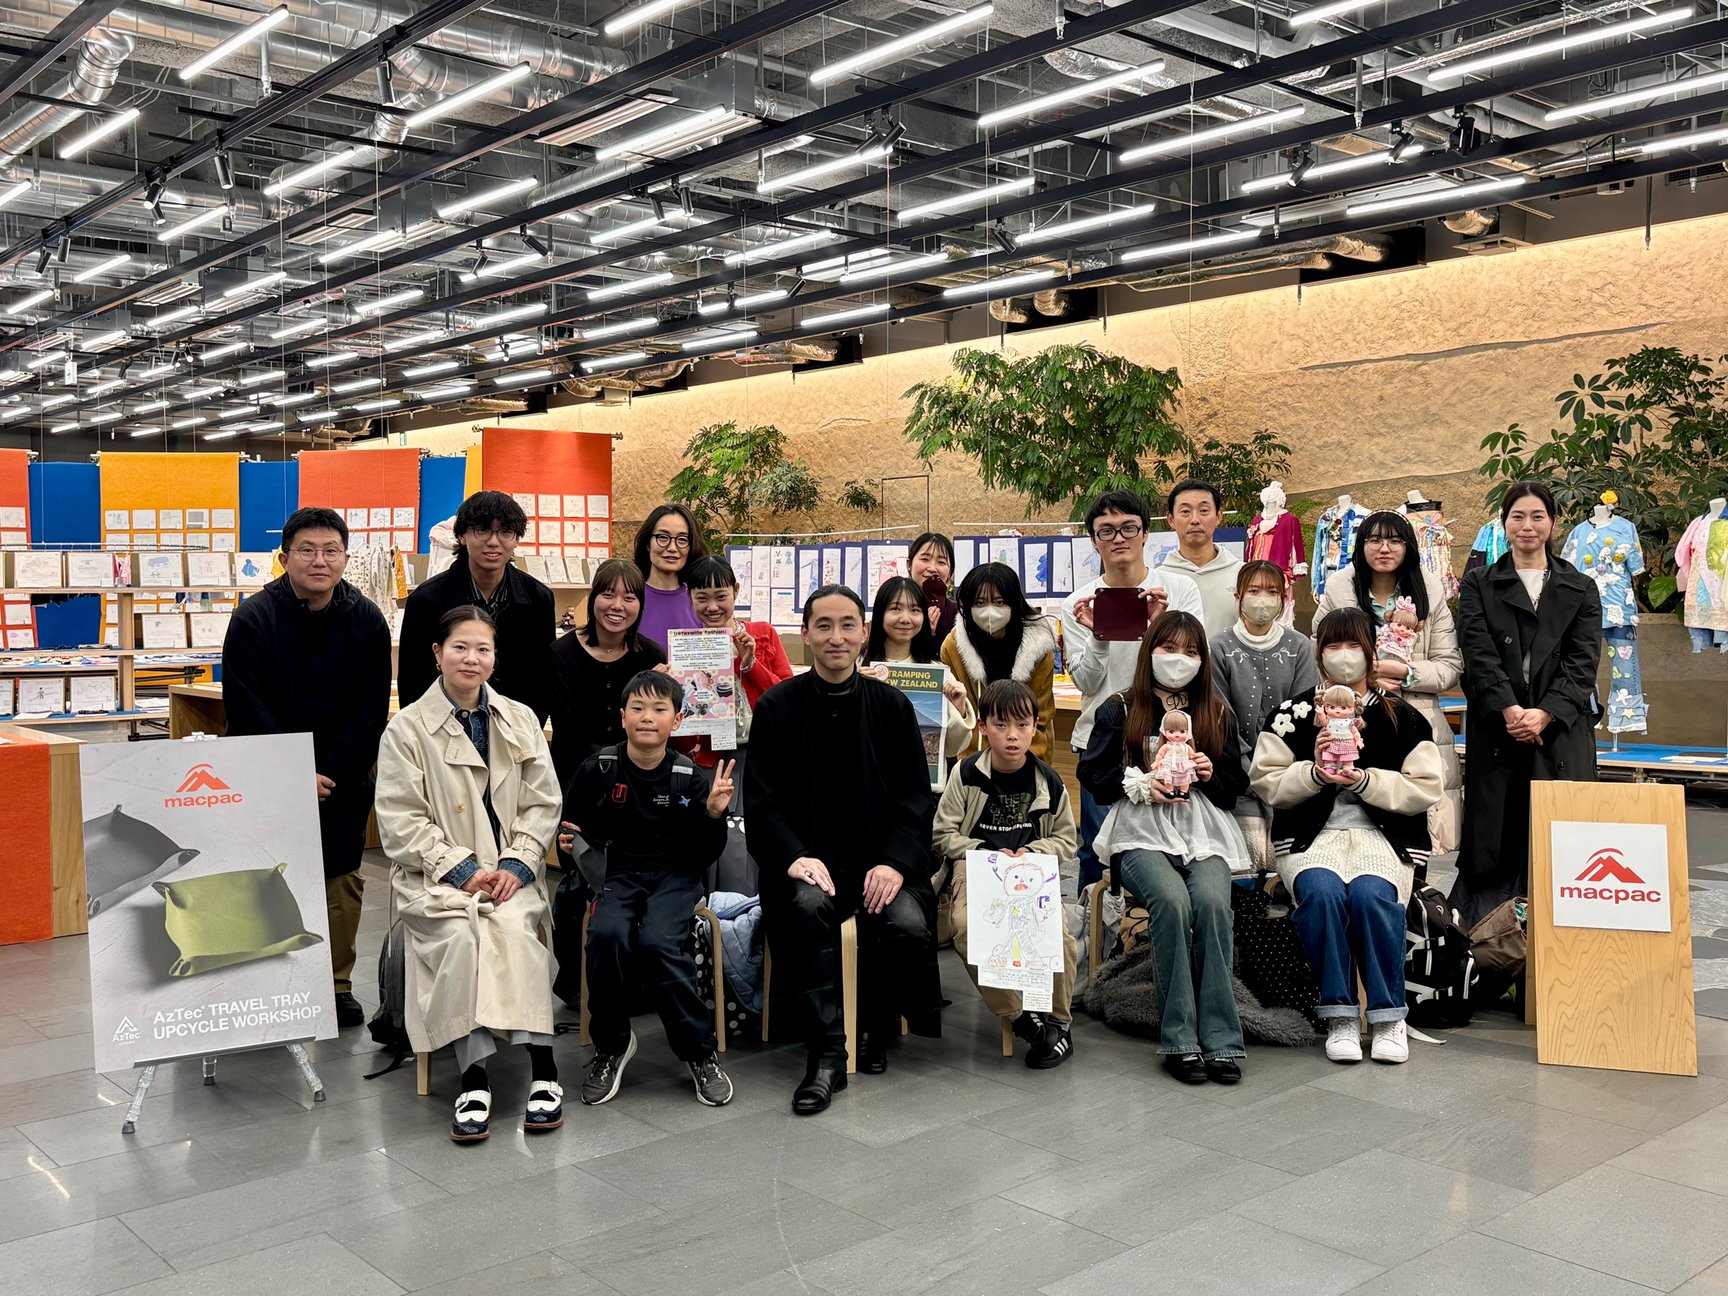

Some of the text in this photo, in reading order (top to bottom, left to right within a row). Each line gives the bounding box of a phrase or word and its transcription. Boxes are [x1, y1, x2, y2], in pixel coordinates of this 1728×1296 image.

[888, 670, 931, 679] TRAMPING
[885, 679, 938, 688] EW ZEALAND
[164, 793, 243, 808] macpac
[997, 793, 1020, 805] THE
[1560, 886, 1662, 904] macpac
[208, 997, 269, 1017] TRAVEL
[270, 991, 311, 1008] TRAY
[153, 1005, 322, 1040] UPCYCLE WORKSHOP
[112, 1032, 142, 1042] AzTec
